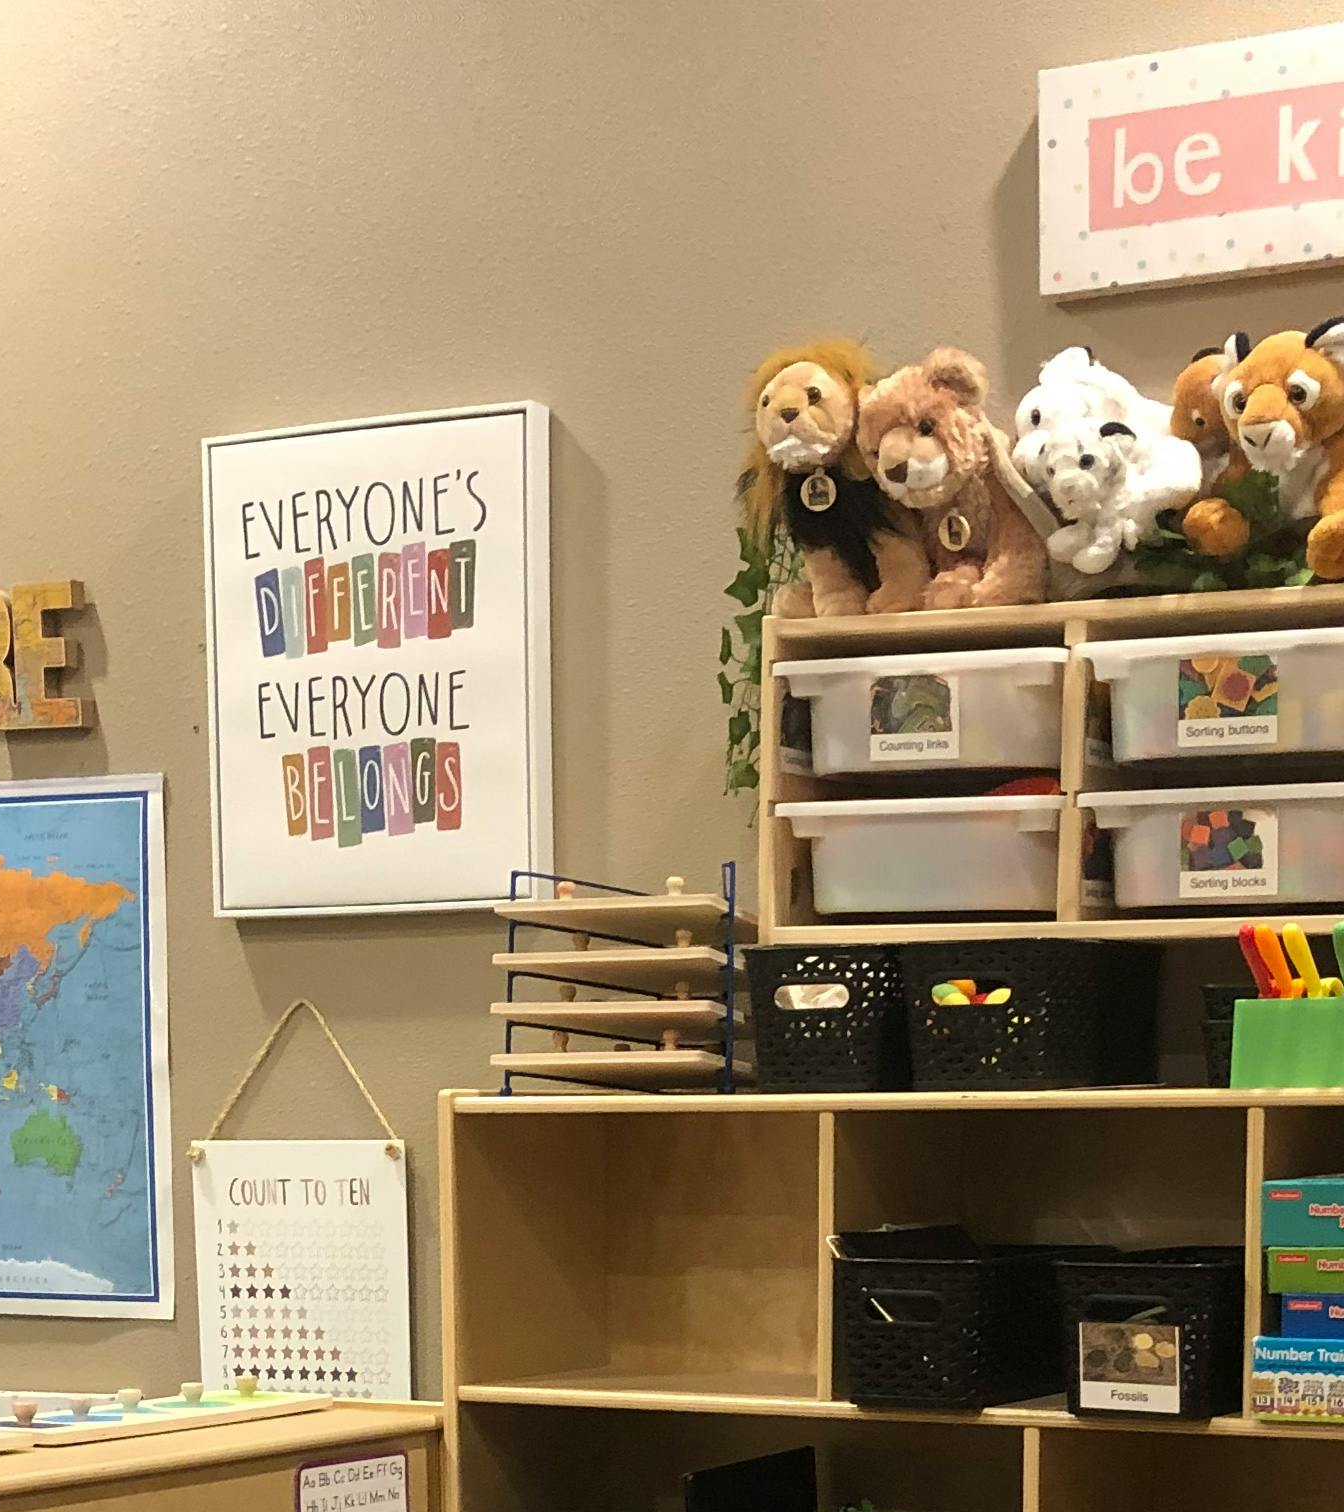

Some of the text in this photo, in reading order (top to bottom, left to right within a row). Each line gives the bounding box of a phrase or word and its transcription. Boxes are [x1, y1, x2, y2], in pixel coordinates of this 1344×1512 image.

[1112, 127, 1222, 209] be
[242, 469, 487, 560] EVERYONE'S
[258, 557, 473, 638] DIFFERENT
[258, 669, 470, 740] EVERYONE
[1185, 722, 1270, 740] Sorting buttons
[878, 737, 950, 755] Counting links
[286, 749, 460, 825] BELONGS
[1189, 874, 1267, 892] Sorting blocks
[229, 1177, 371, 1206] COUNT TO TEN
[217, 1219, 223, 1234] 1
[217, 1243, 223, 1256] 2
[218, 1263, 225, 1279] 3
[219, 1284, 226, 1299] 4
[220, 1305, 227, 1319] 5
[220, 1325, 227, 1339] 6
[222, 1345, 228, 1358] 7
[1254, 1347, 1313, 1362] Number
[1110, 1389, 1149, 1403] Fossils
[303, 1476, 315, 1488] Aa
[348, 1468, 359, 1482] Dd
[363, 1466, 374, 1480] Ee
[390, 1462, 402, 1480] Gg
[307, 1500, 319, 1512] Hh
[344, 1494, 355, 1507] Kk
[370, 1492, 385, 1504] Mm
[388, 1488, 400, 1500] Nn
